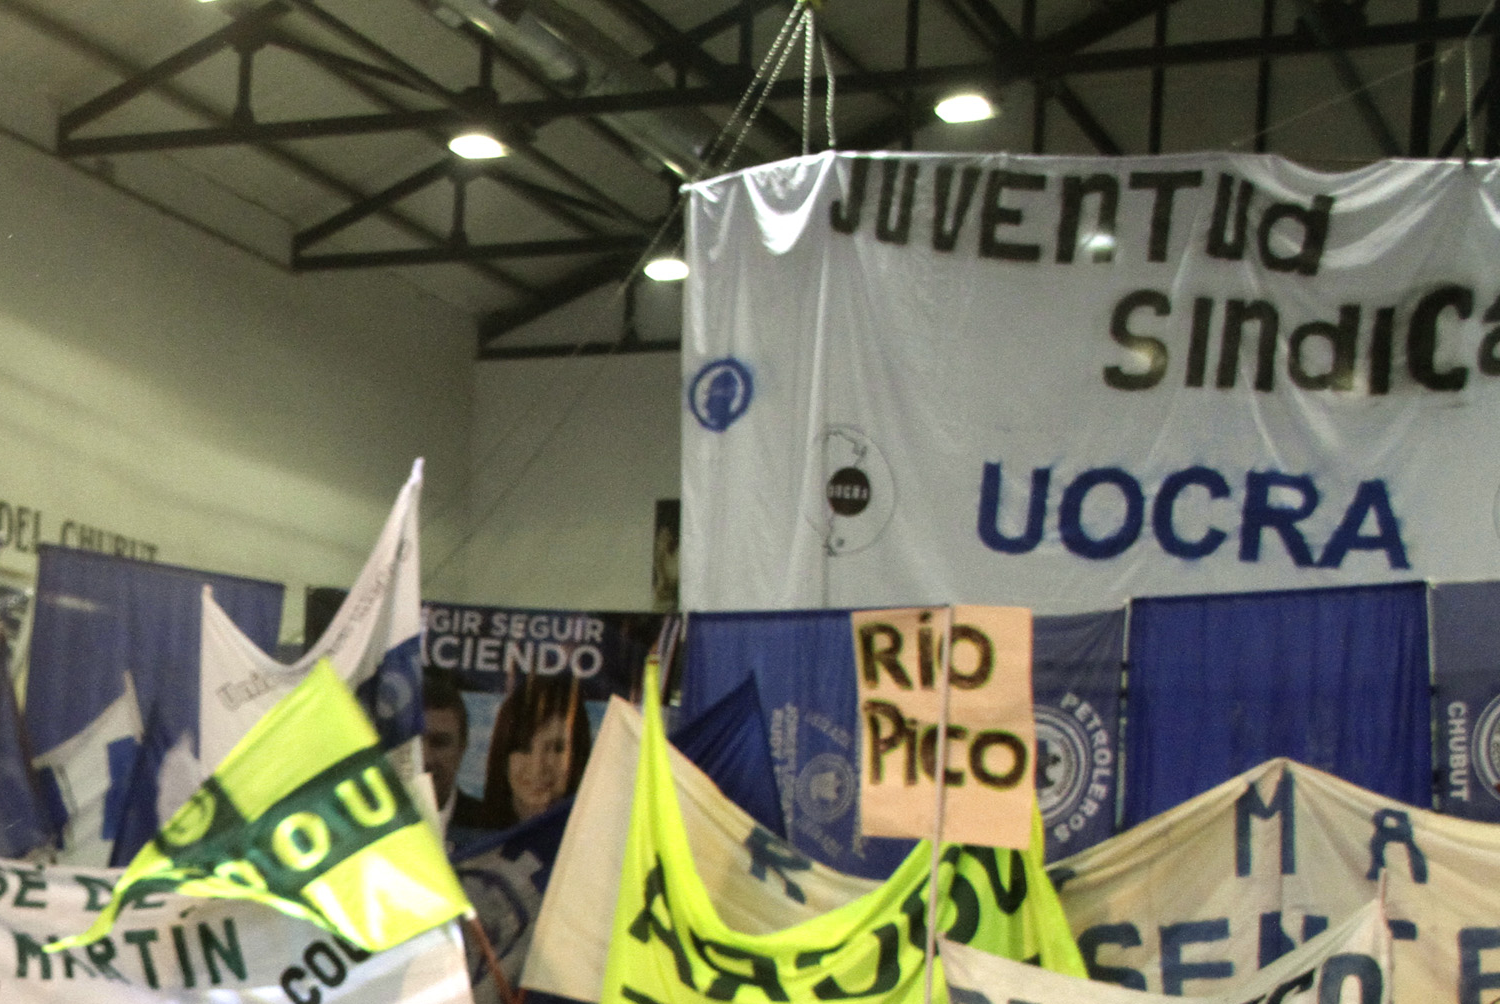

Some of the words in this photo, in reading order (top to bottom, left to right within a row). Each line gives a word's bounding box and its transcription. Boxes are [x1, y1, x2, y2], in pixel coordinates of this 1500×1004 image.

[976, 461, 1411, 570] UOCRA
[491, 612, 605, 643] SEGUIR
[1054, 691, 1114, 844] PETROLEROS
[1447, 700, 1473, 803] CHUBUT
